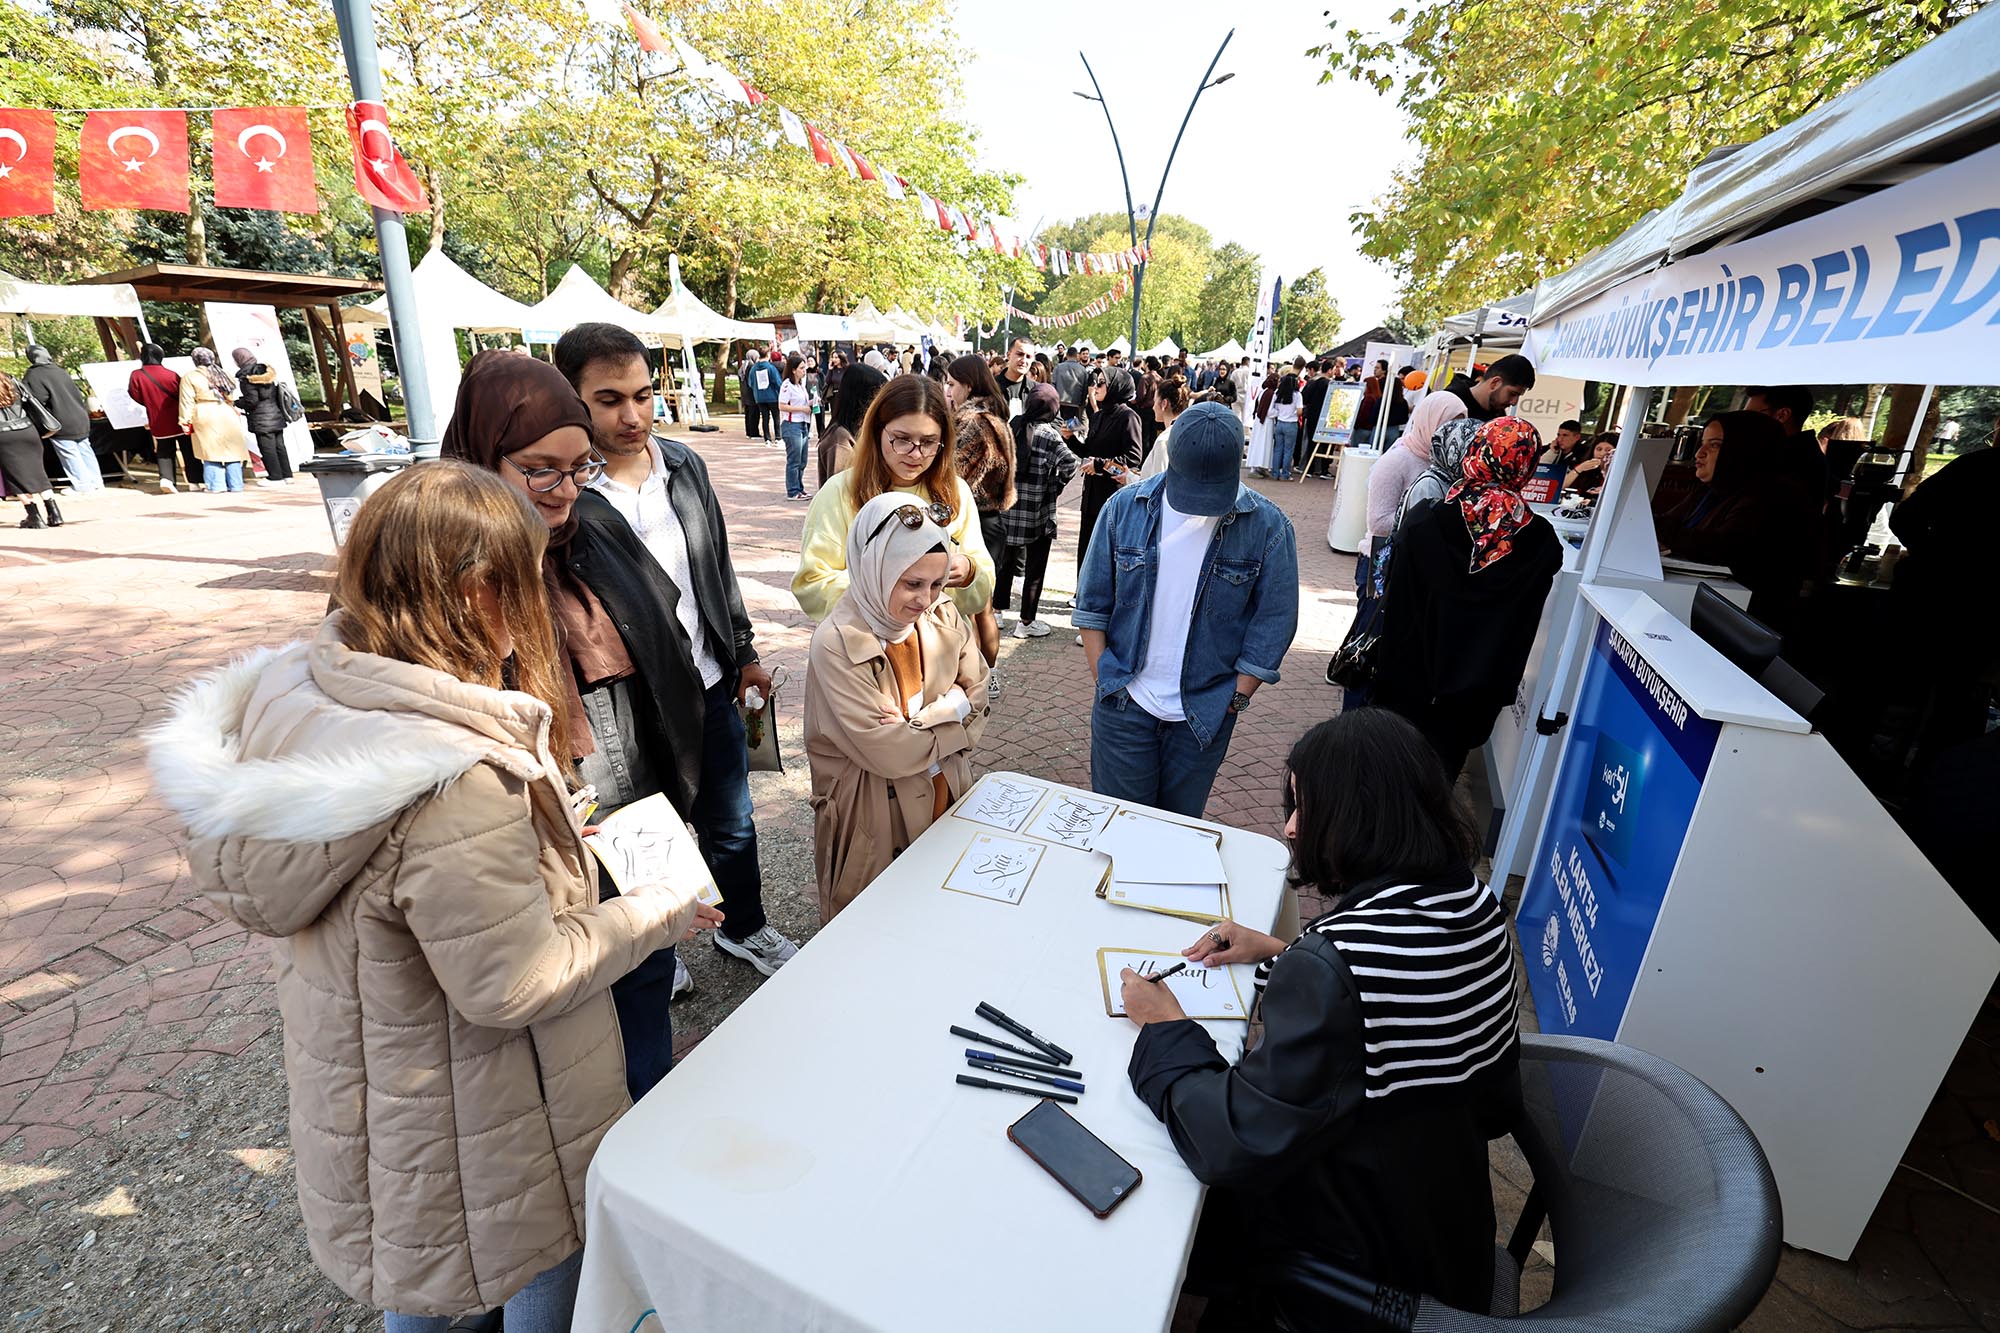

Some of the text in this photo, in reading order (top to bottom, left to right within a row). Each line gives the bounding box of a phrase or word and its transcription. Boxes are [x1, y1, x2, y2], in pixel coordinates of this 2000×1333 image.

[1552, 207, 2000, 371] SAKARYA BÜYÜKŞEHİR BELED
[1608, 627, 1639, 673] SAKARYA
[1635, 657, 1688, 731] BÜYÜKŞEHİR
[1551, 841, 1604, 999] İŞLEM MERKEZİ
[1568, 846, 1599, 930] KART54
